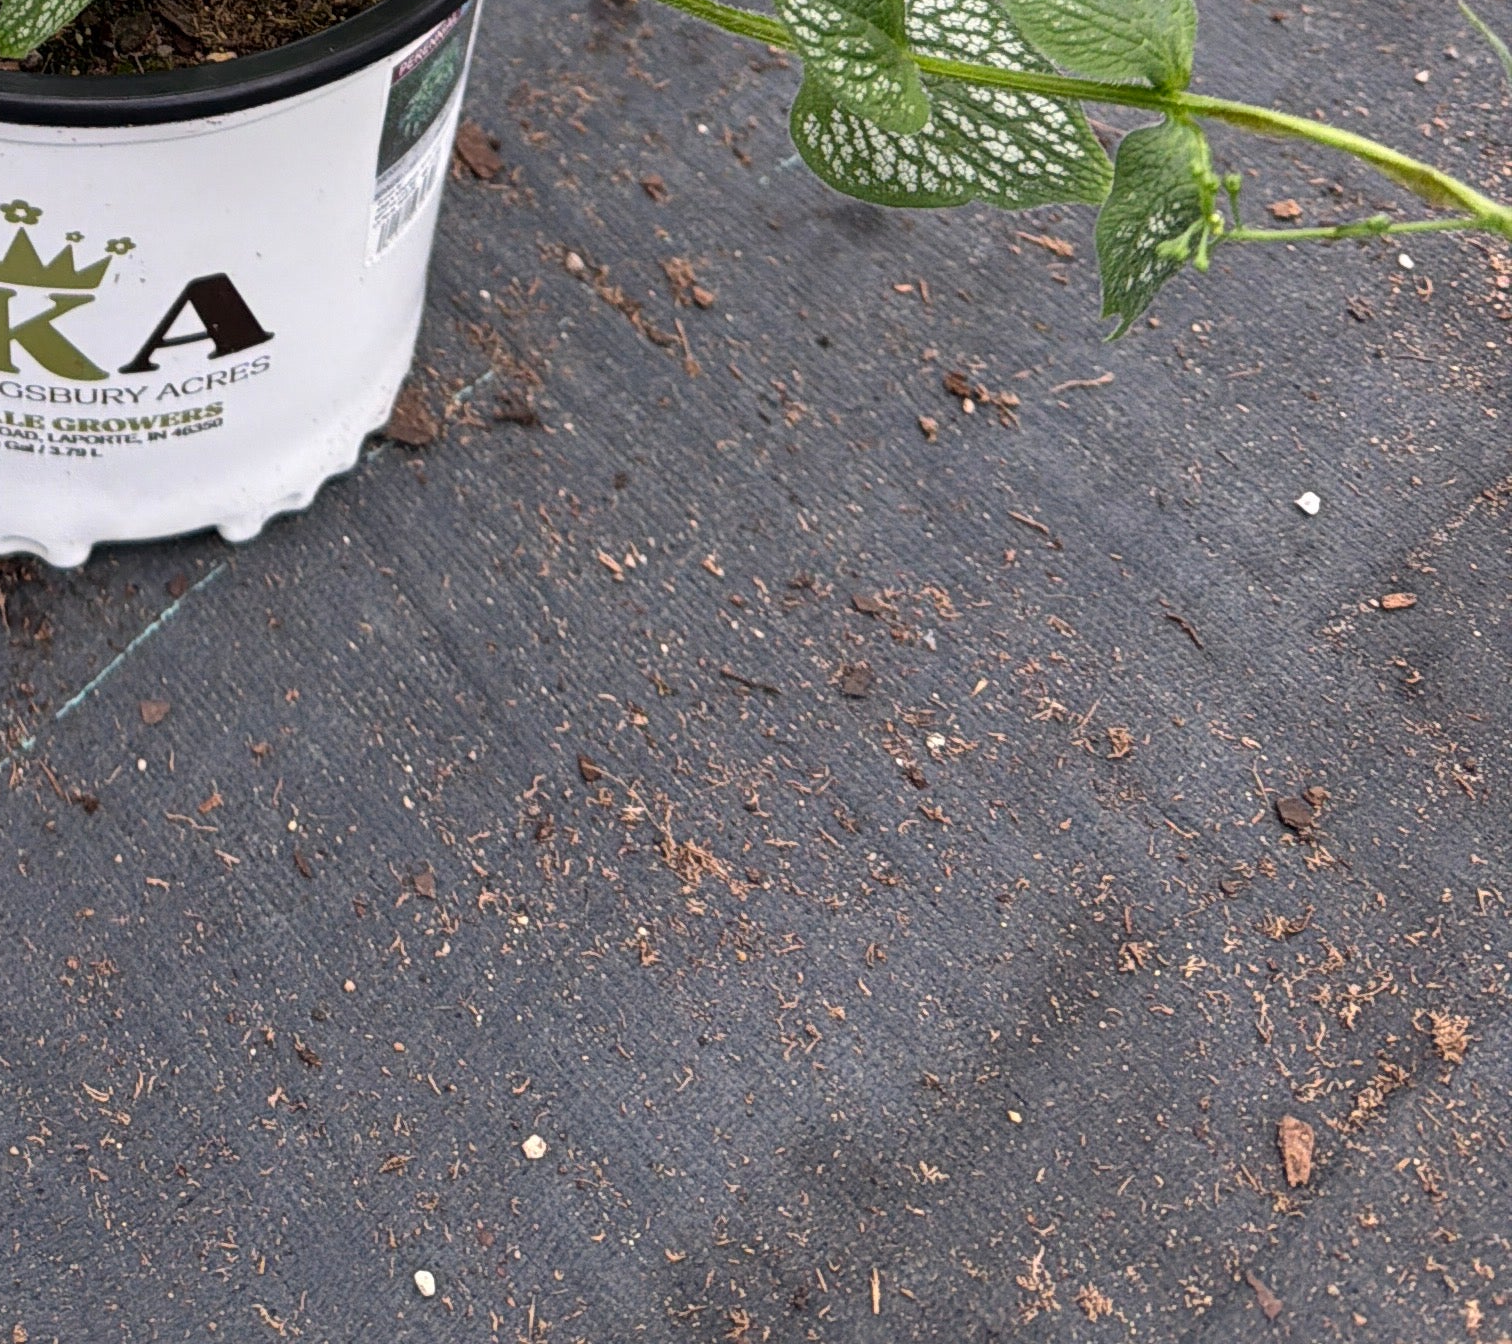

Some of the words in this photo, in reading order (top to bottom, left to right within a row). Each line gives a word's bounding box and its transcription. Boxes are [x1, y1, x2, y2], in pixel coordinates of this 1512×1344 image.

[156, 354, 271, 401] ACRES
[52, 401, 224, 433] GROWERS
[147, 429, 167, 441] IN
[5, 440, 34, 453] Gal
